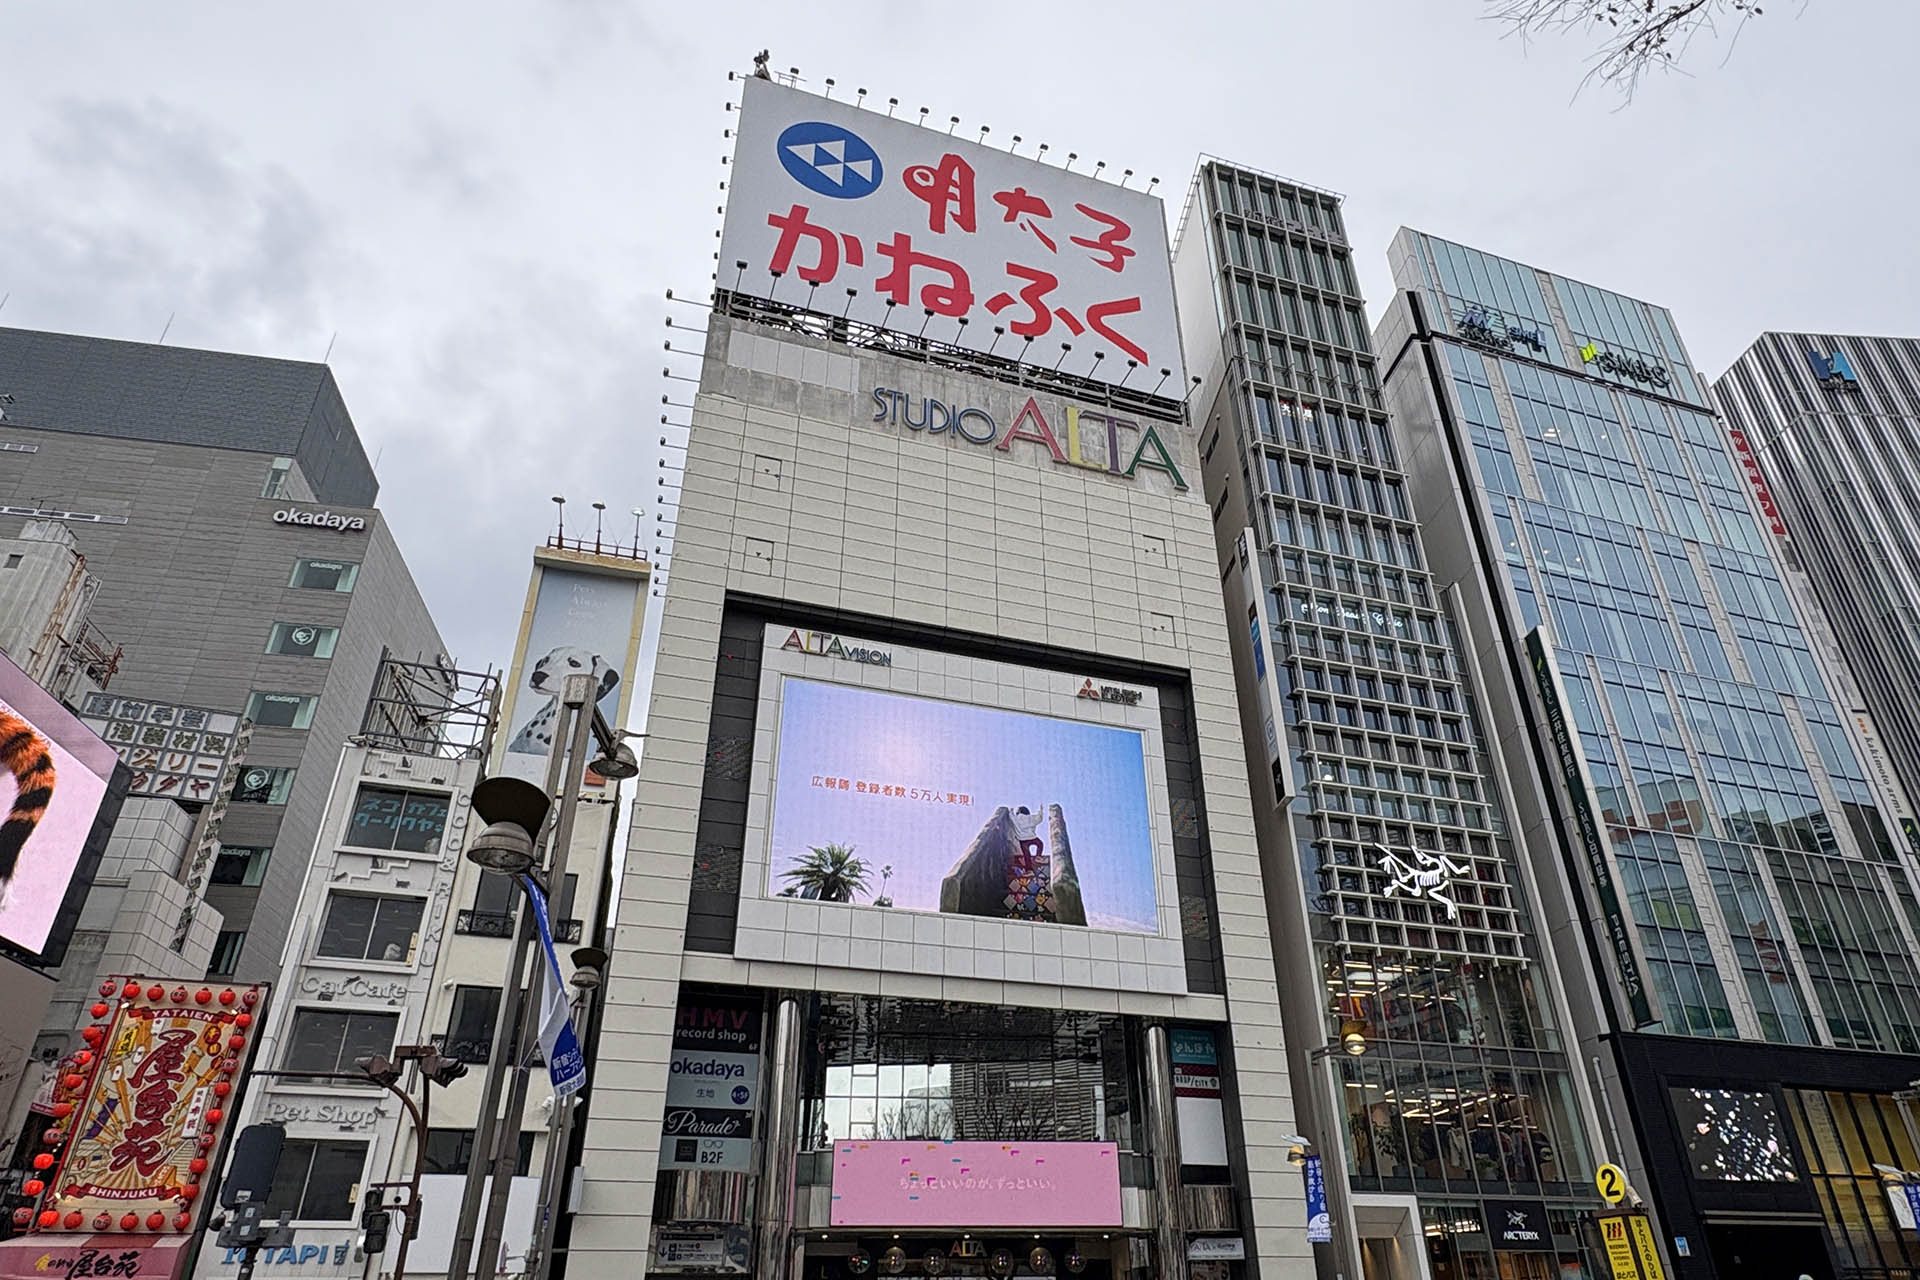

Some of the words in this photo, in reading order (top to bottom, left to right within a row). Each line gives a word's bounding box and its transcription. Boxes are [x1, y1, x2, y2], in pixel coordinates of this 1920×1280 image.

[903, 153, 1136, 272] 明太子
[767, 204, 1149, 366] かねふく
[873, 387, 996, 444] STUDIO
[995, 395, 1190, 491] ALTA
[273, 508, 365, 531] okadaya
[1886, 786, 1904, 815] arms
[152, 1008, 214, 1023] YATAIEN
[677, 1007, 749, 1029] HMV
[676, 1028, 715, 1039] record
[717, 1028, 746, 1043] shop
[671, 1057, 745, 1080] okadaya
[317, 1105, 377, 1125] Shop
[664, 1109, 740, 1135] Parade
[701, 1151, 723, 1164] B2F
[88, 1185, 158, 1199] SHINJUKU
[1601, 1168, 1620, 1197] 2
[950, 1240, 987, 1257] ALTA
